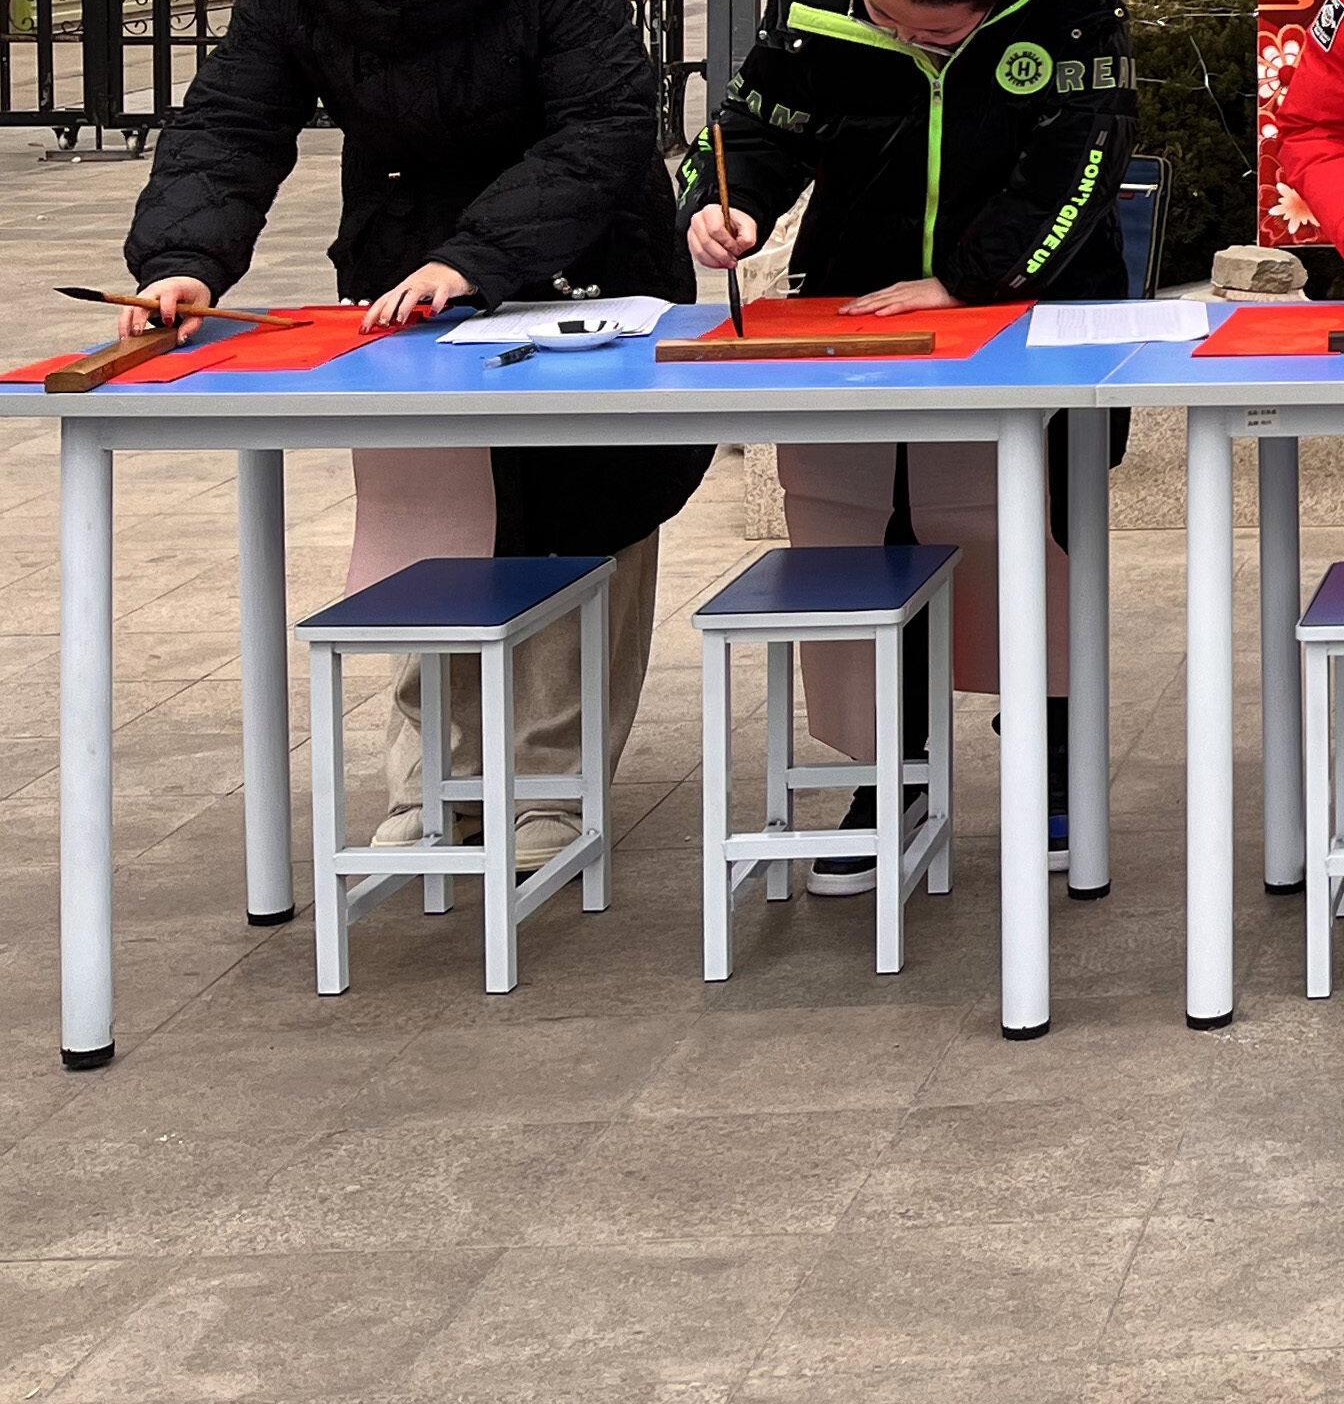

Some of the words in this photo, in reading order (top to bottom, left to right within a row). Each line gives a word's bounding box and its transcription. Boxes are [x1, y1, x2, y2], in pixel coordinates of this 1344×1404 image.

[1070, 149, 1104, 207] DON'T
[1042, 204, 1079, 251] GIVE
[1026, 248, 1051, 274] UP
